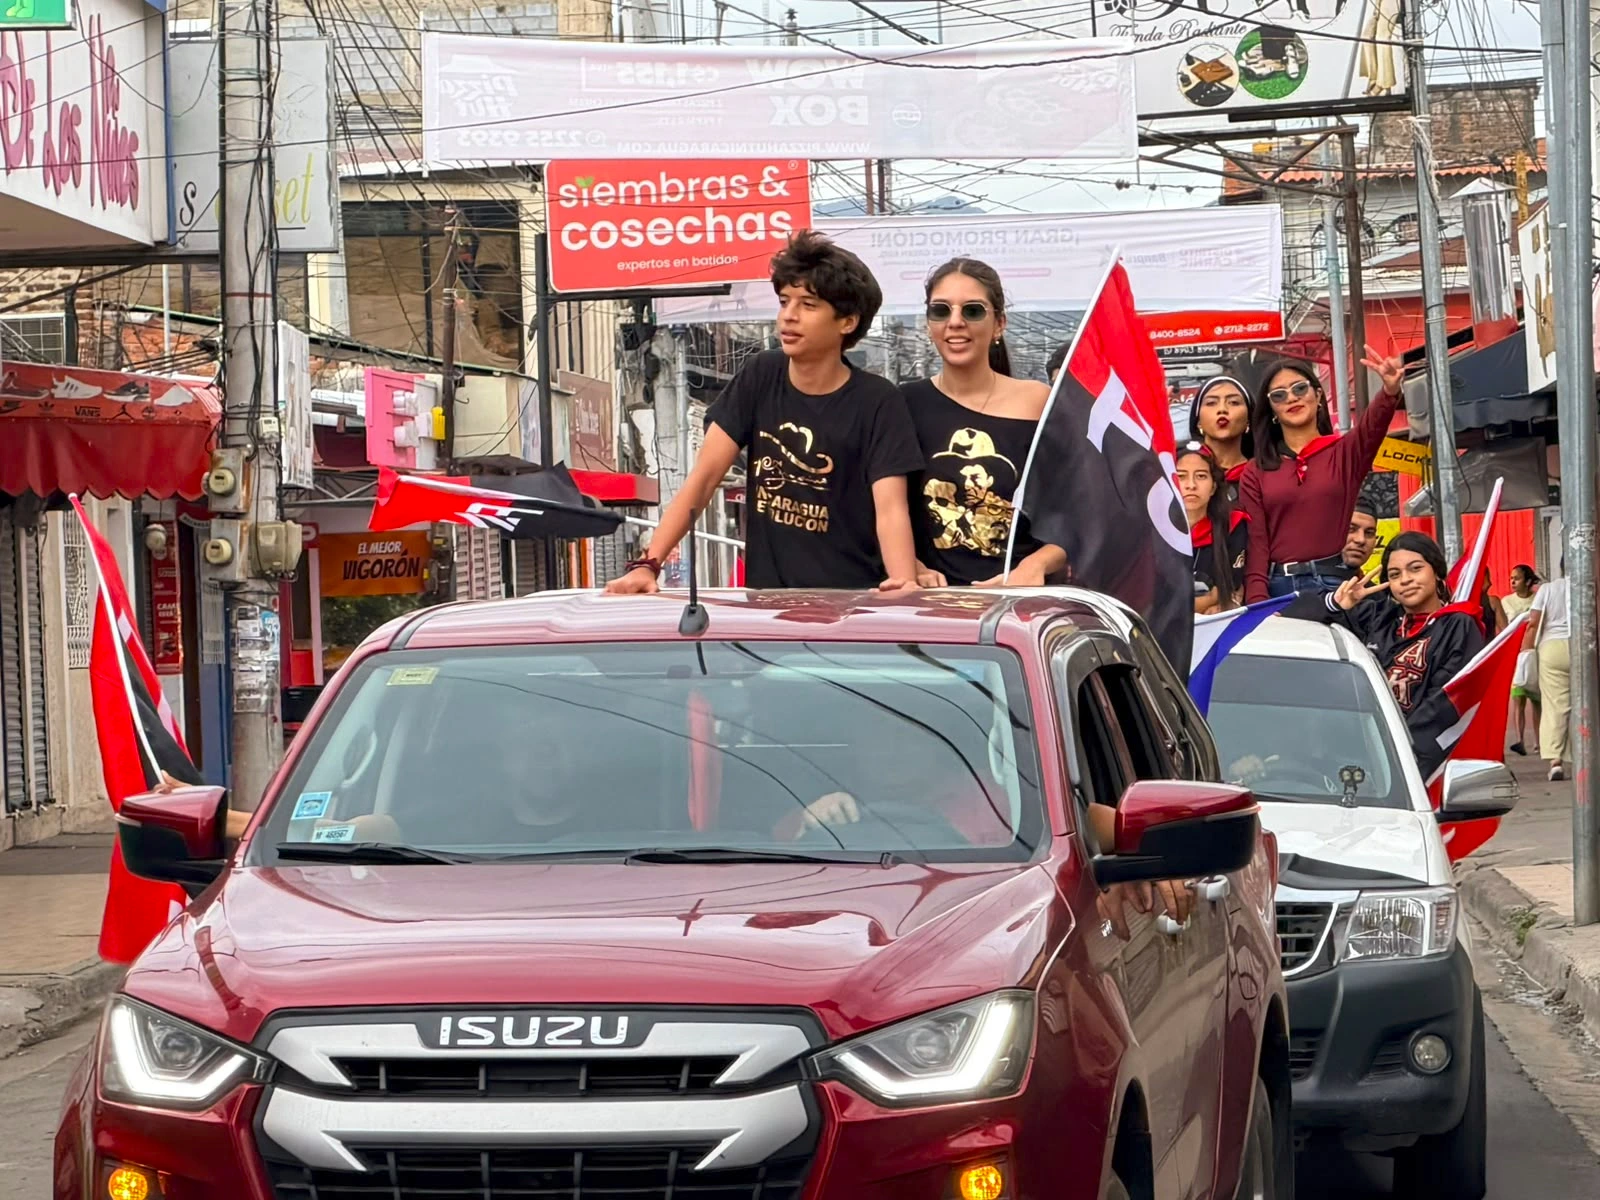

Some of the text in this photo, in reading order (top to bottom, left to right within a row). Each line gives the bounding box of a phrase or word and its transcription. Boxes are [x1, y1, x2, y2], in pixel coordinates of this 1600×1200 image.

[559, 165, 790, 209] siembras &
[560, 208, 793, 251] cosechas
[616, 253, 739, 273] expertos en batidos
[1223, 322, 1270, 335] 2712-2272
[74, 405, 101, 418] VANS
[357, 541, 402, 555] EL MEJOR
[343, 549, 421, 580] VIGORÓN
[439, 1016, 629, 1046] ISUZU
